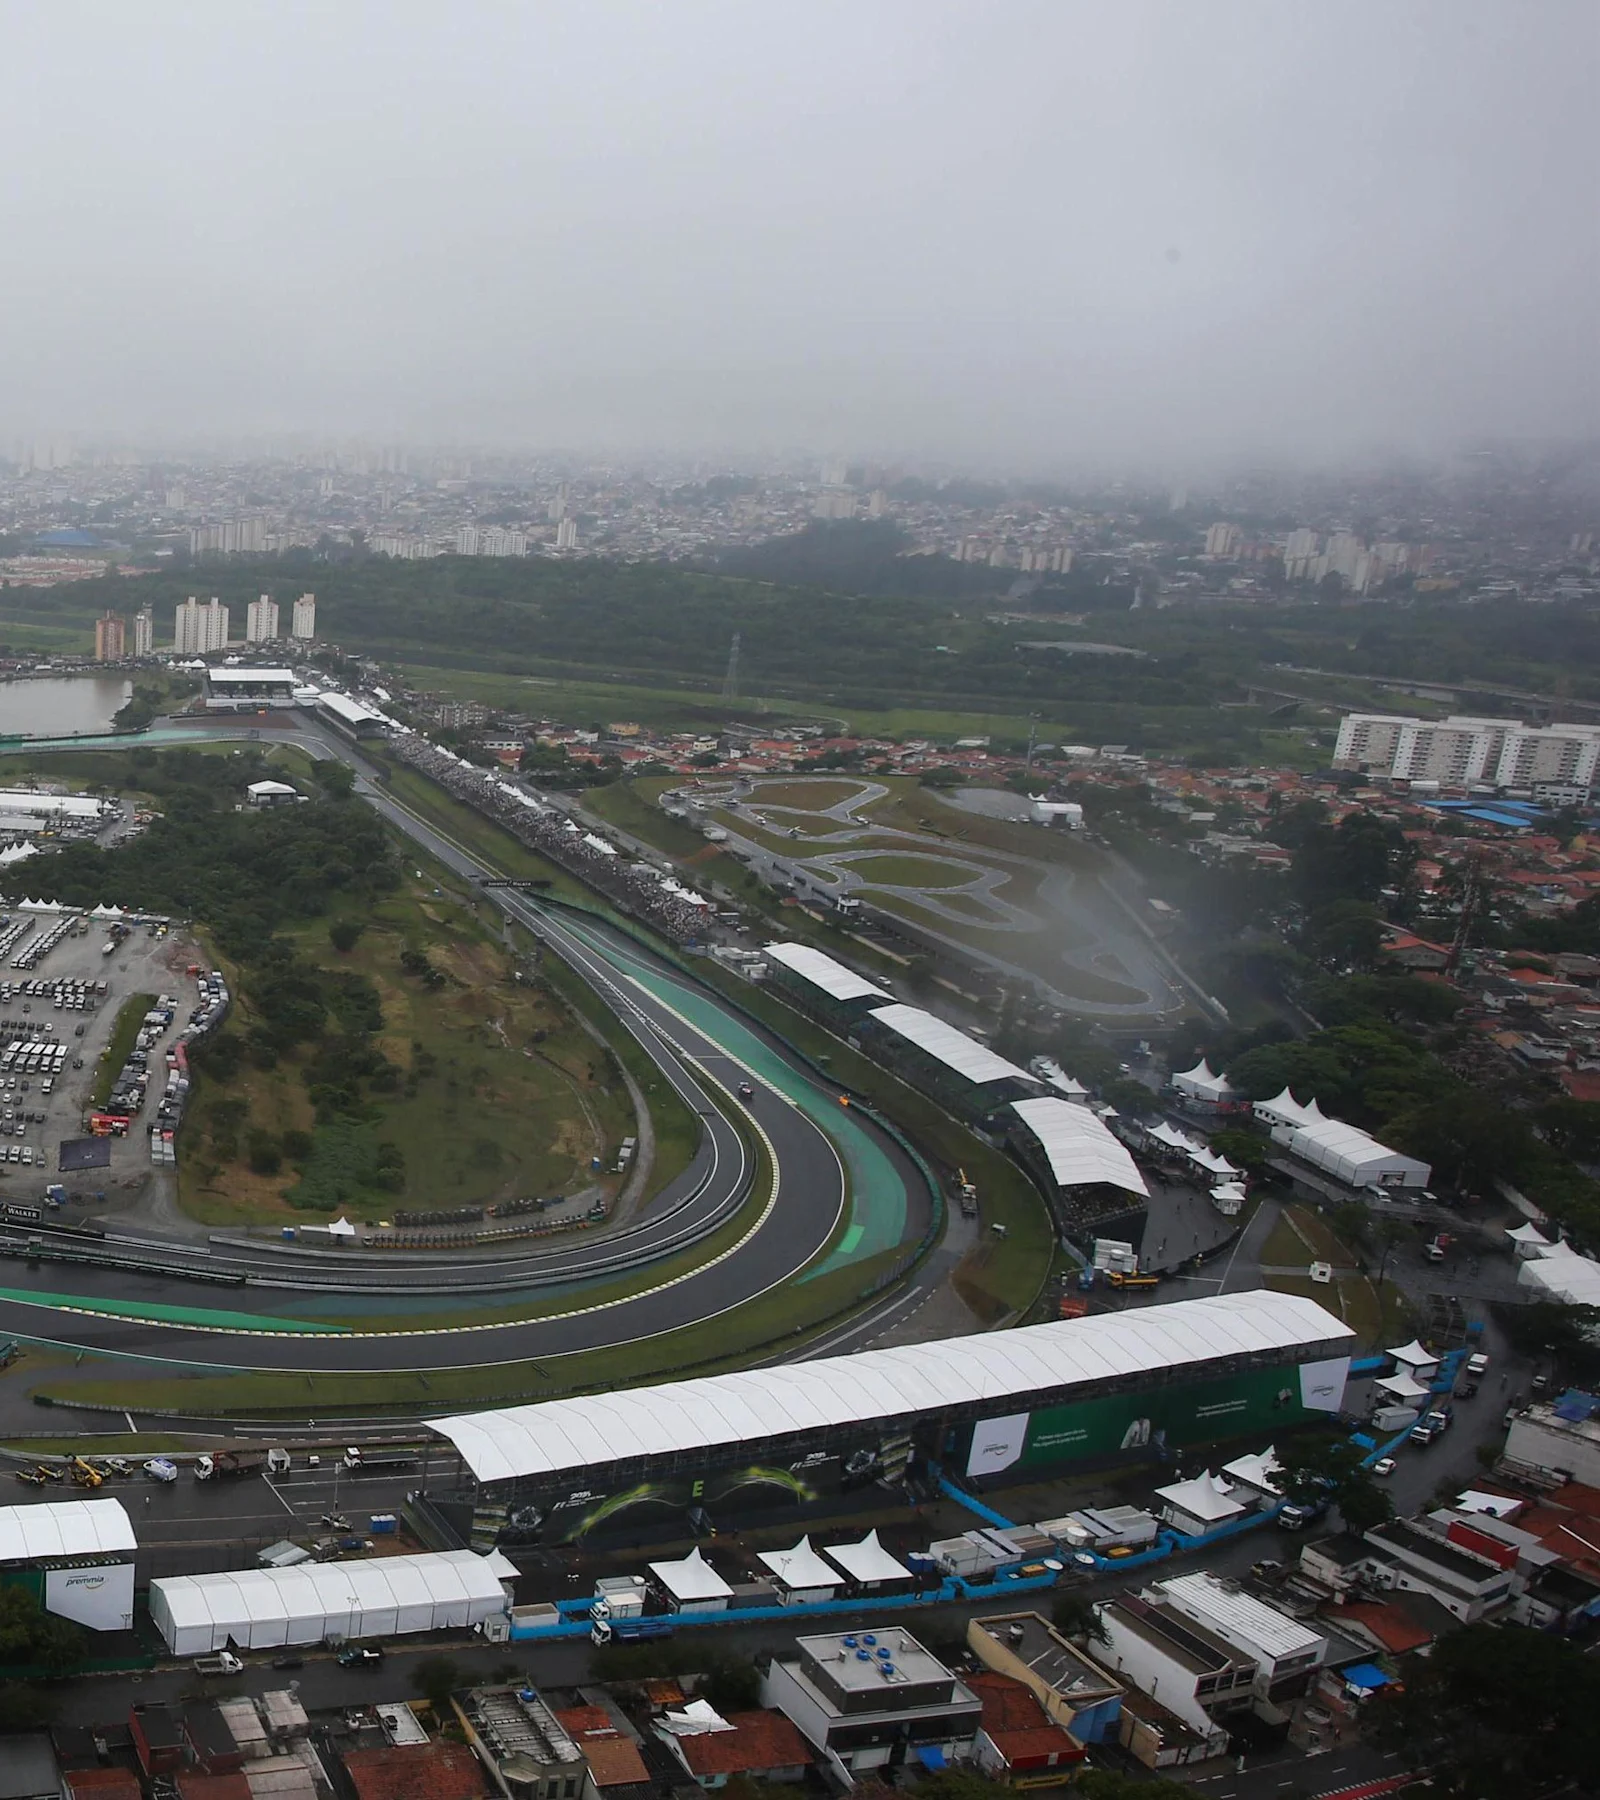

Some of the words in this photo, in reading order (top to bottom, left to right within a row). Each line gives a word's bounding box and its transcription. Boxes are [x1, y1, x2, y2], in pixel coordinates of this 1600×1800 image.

[7, 1207, 38, 1218] WALKER
[692, 1480, 704, 1497] E
[66, 1575, 105, 1588] premmia
